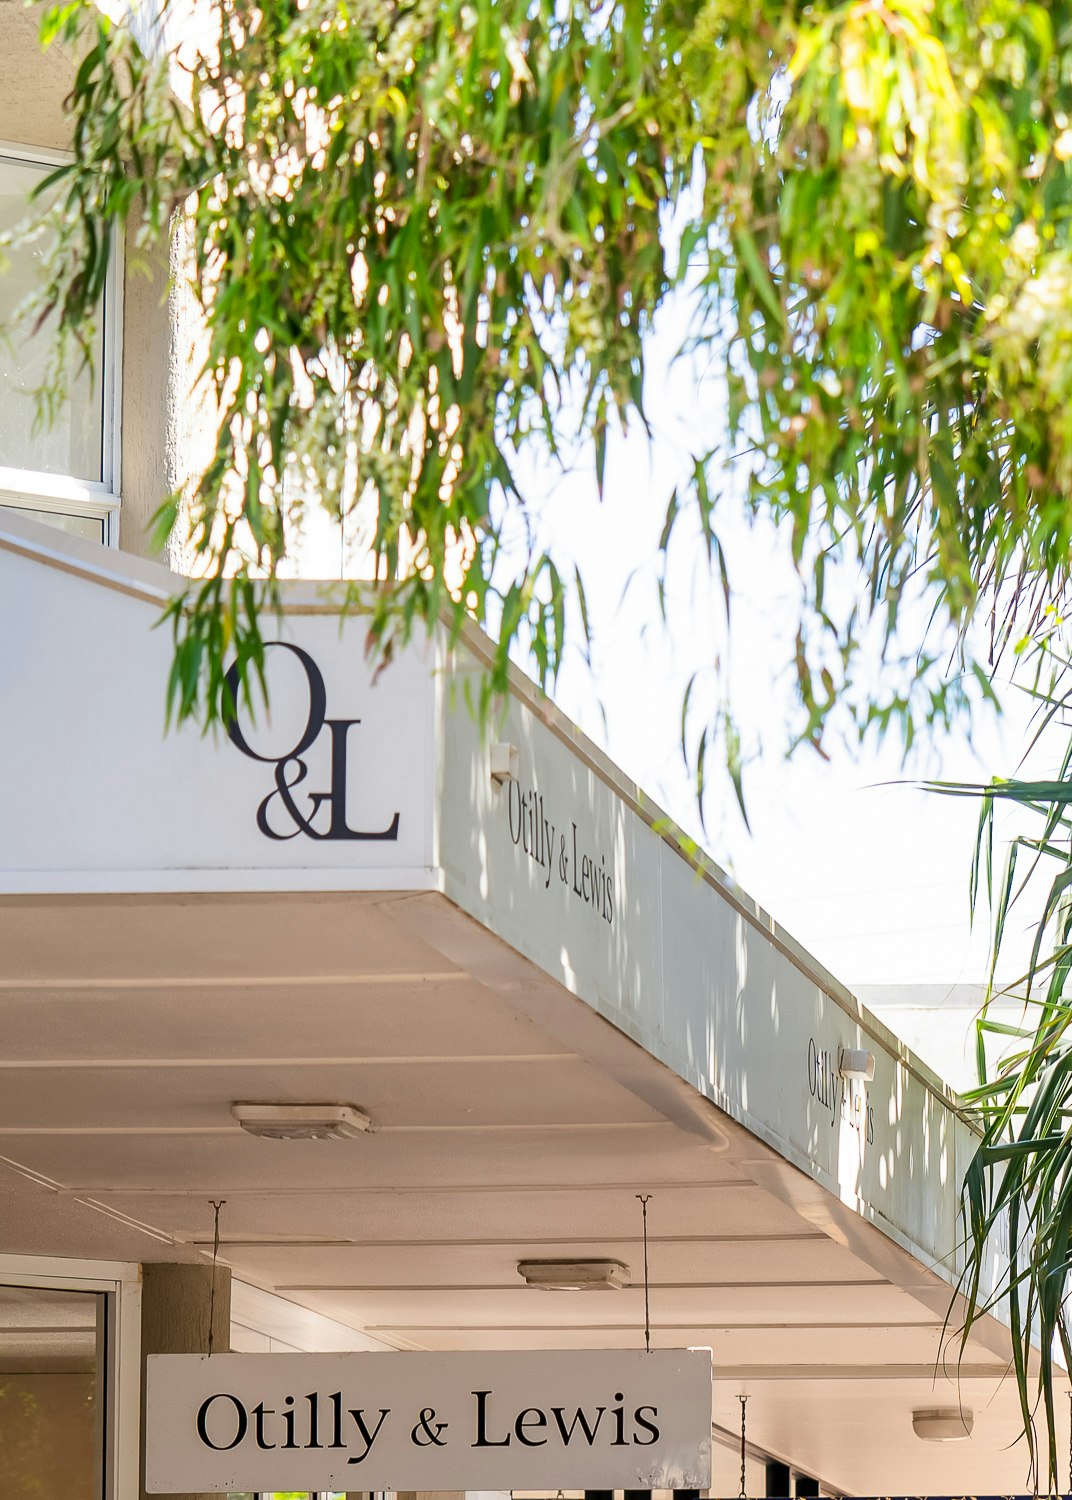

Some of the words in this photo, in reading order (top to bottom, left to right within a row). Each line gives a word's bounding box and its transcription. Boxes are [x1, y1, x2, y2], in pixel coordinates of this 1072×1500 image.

[508, 779, 555, 889] Otilly
[559, 834, 569, 885] &
[571, 822, 613, 925] Lewis
[196, 1391, 392, 1465] Otilly
[411, 1406, 449, 1447] &
[470, 1390, 661, 1447] Lewis
